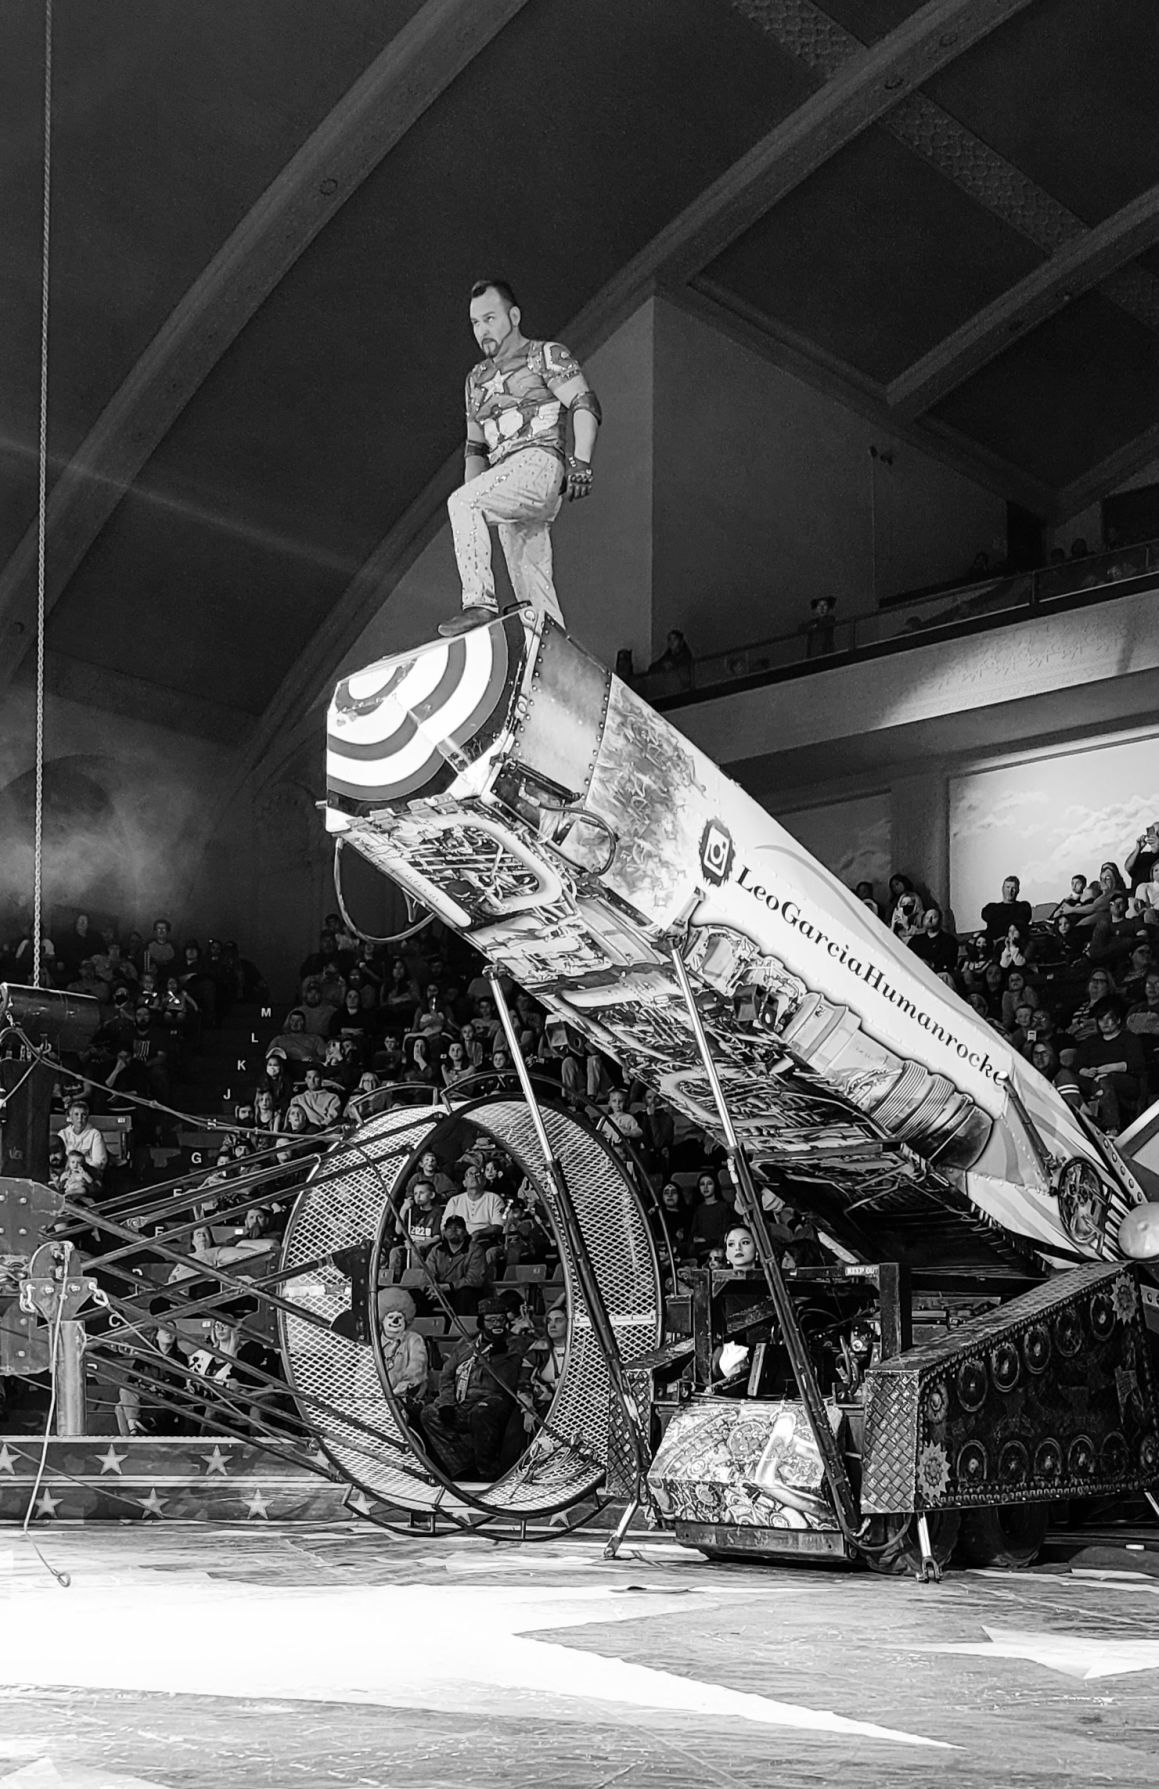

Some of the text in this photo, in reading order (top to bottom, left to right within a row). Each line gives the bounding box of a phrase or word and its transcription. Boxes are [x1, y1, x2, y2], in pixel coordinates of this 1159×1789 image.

[735, 864, 1010, 1093] LeoGarciaHumanrocke
[260, 1006, 272, 1018] M
[251, 1032, 259, 1043] L
[237, 1059, 247, 1071] K
[223, 1088, 231, 1100] J
[191, 1151, 202, 1164] G
[108, 1313, 121, 1328] C
